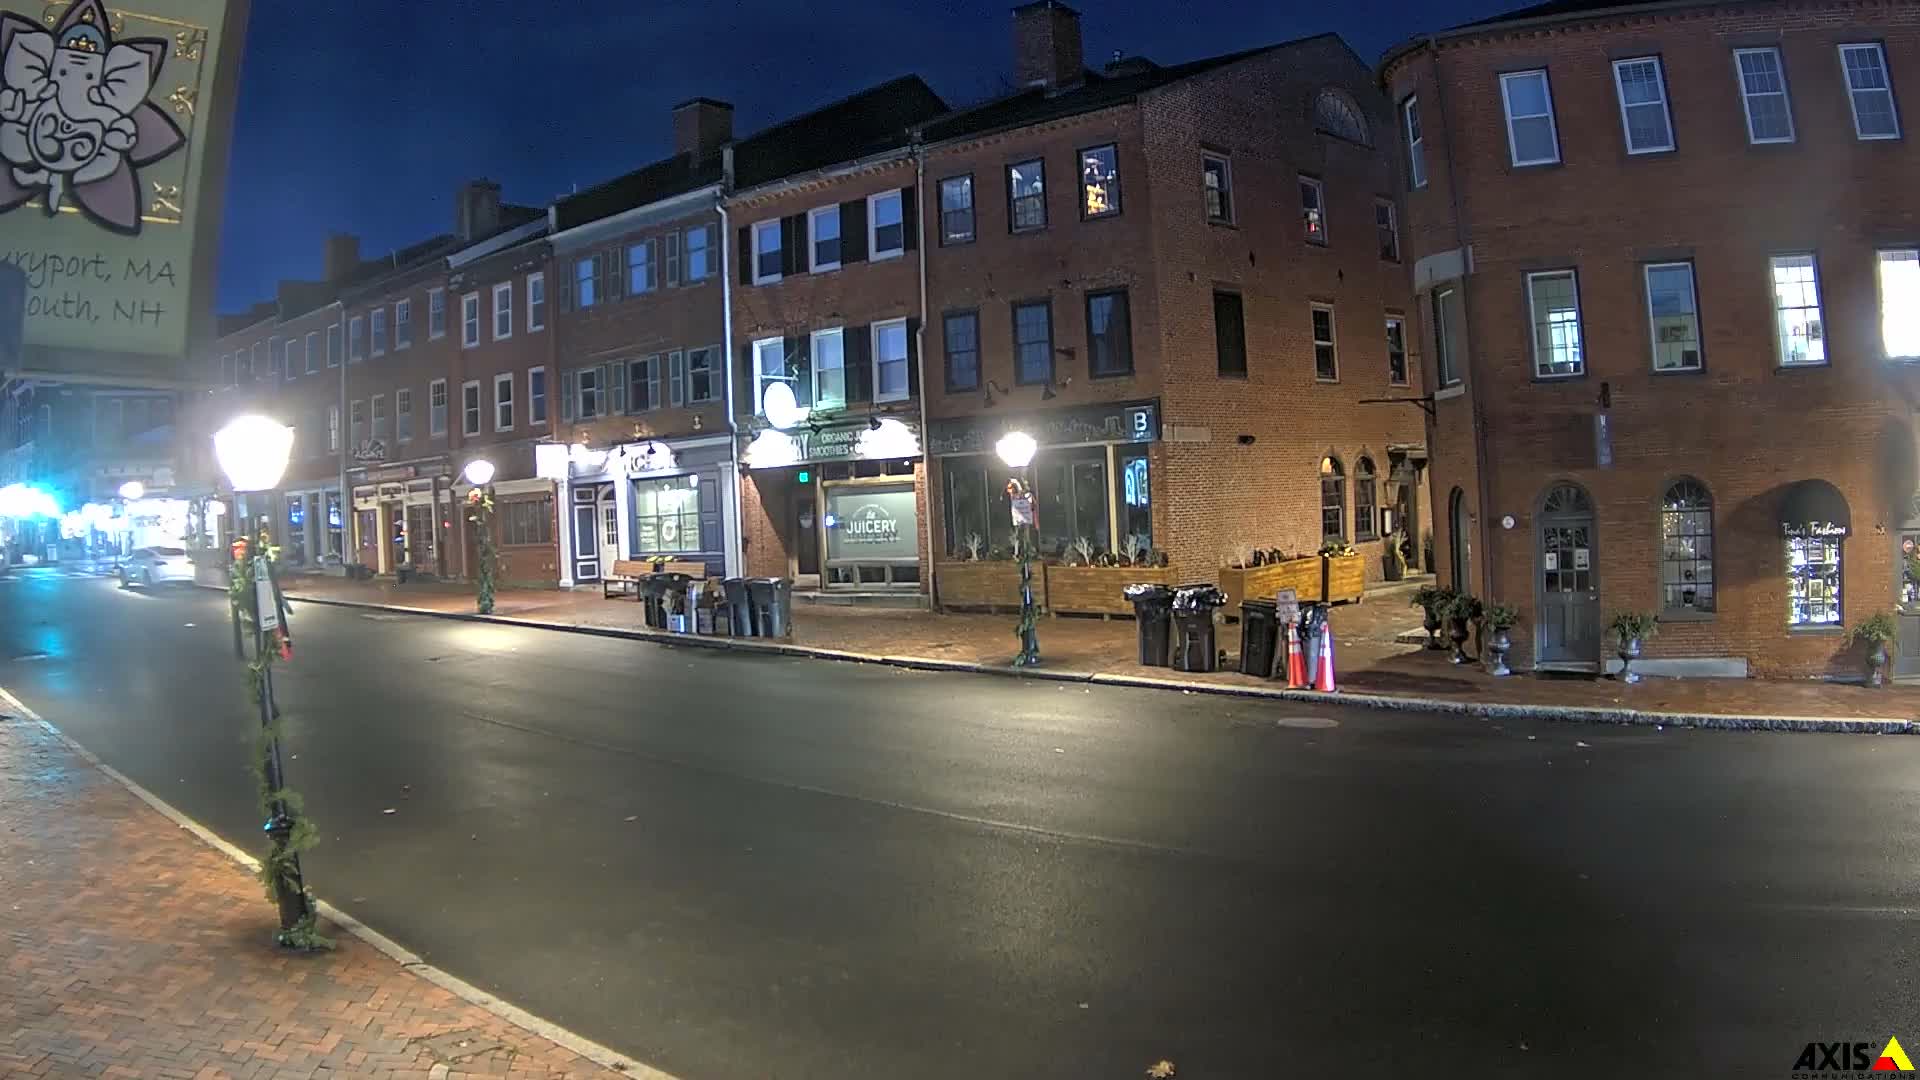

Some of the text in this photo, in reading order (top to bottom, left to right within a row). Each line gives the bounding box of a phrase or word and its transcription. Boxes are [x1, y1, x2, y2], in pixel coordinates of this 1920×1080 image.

[123, 257, 176, 287] MA
[113, 297, 167, 328] NH
[821, 432, 854, 444] ORGANIC
[847, 520, 897, 533] JUICERY
